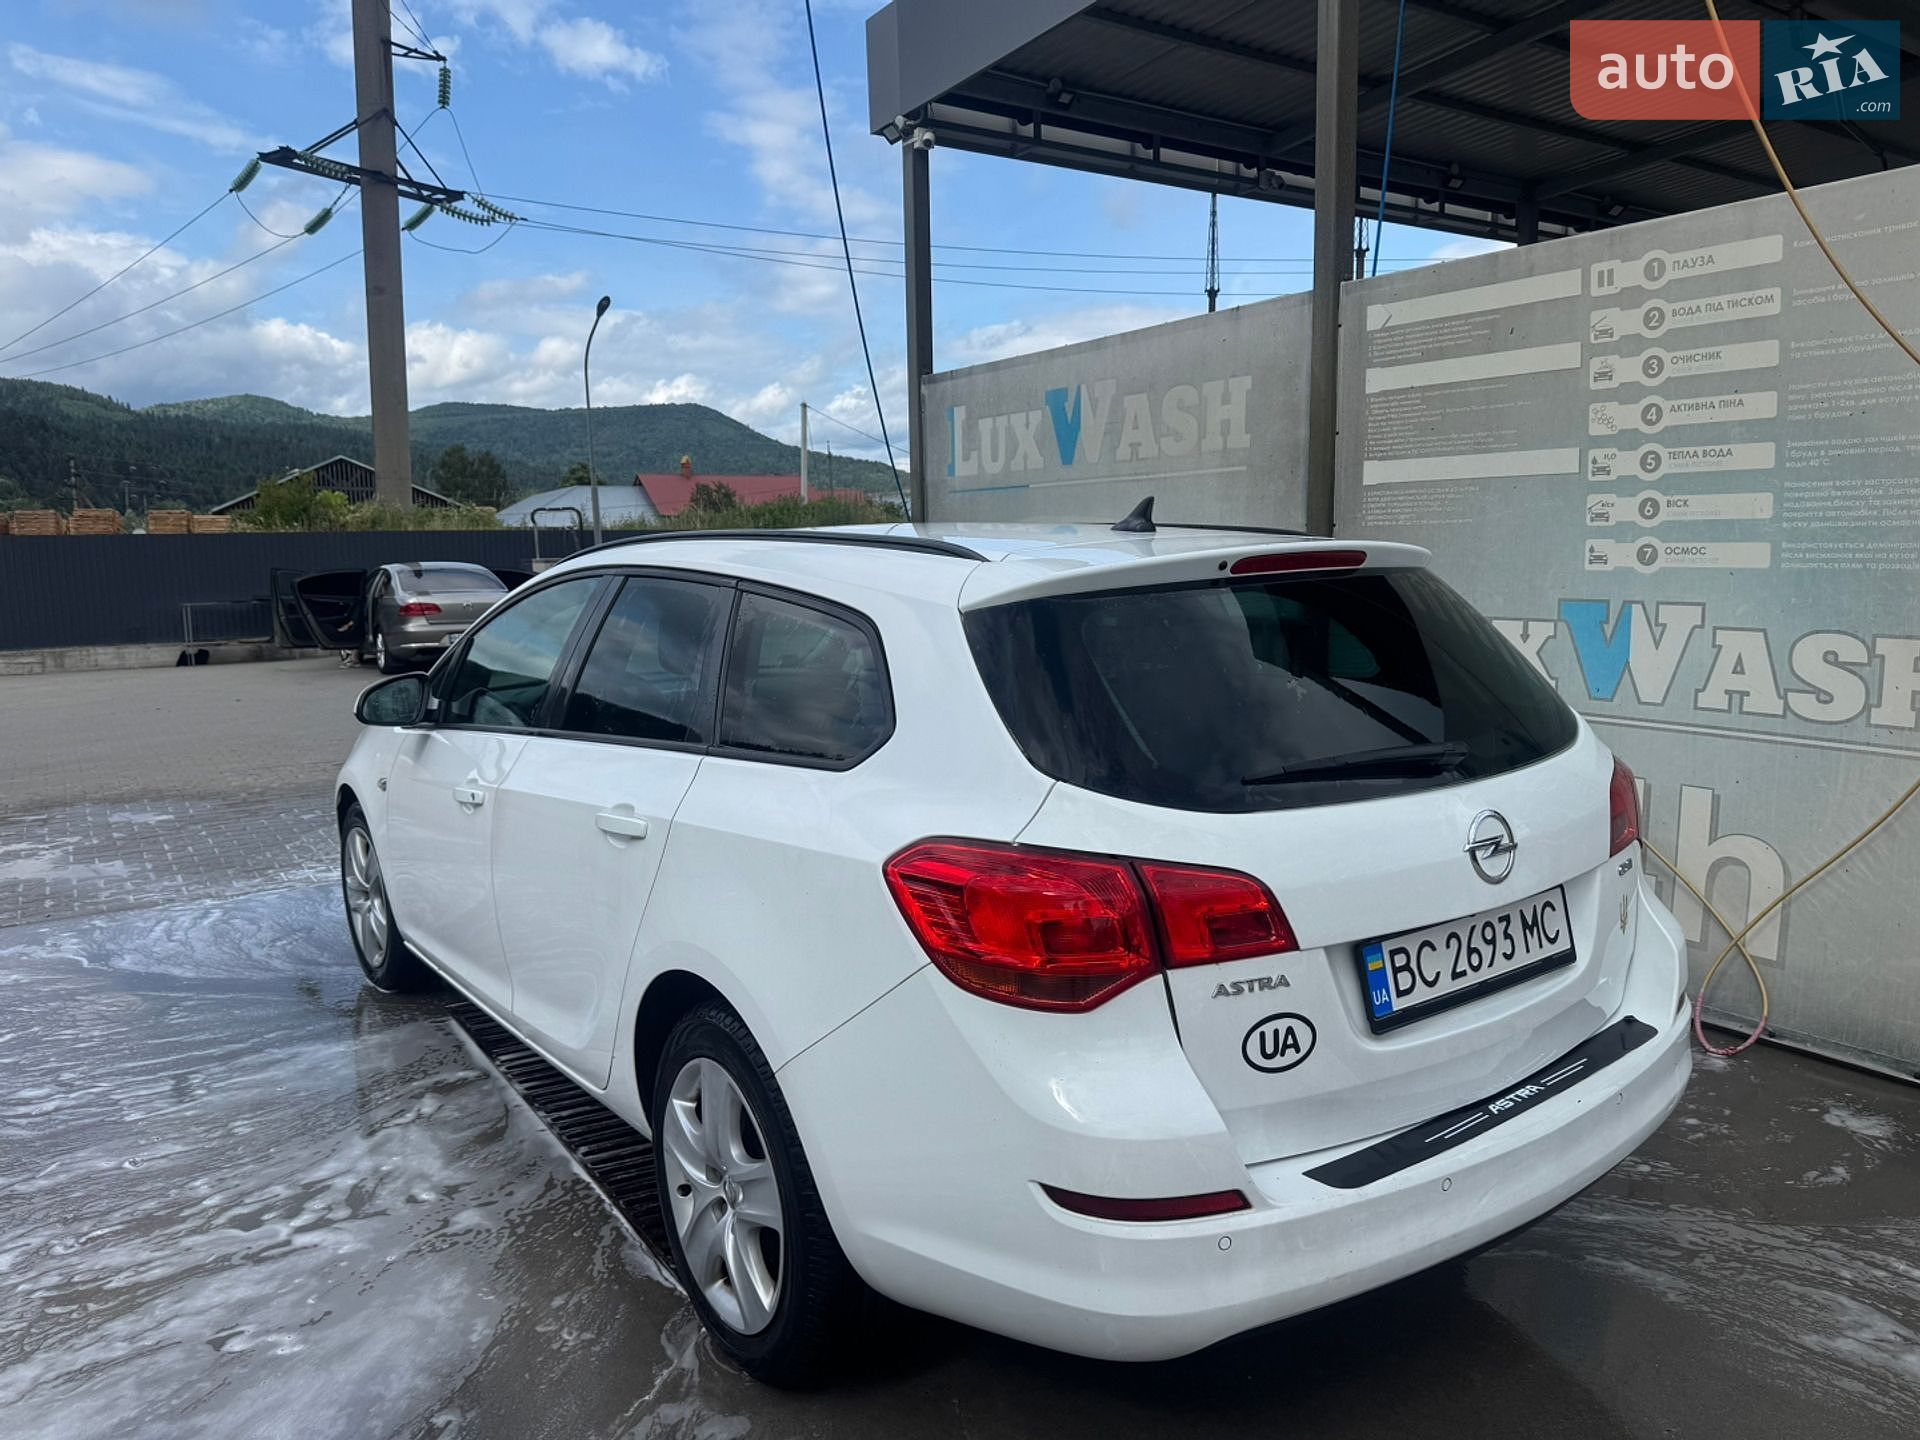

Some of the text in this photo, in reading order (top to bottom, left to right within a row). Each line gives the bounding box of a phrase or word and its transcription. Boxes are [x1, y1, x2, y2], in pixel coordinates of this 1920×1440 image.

[1671, 255, 1715, 272] ПАУЗА
[1671, 304, 1700, 318] ВОДА
[1705, 302, 1724, 313] ПІД
[1727, 294, 1775, 310] ТИСКОМ
[1670, 351, 1723, 366] ОЧИСНИК
[1669, 400, 1715, 414] АКТИВНА
[1718, 398, 1745, 409] ПІНА
[1667, 450, 1700, 461] ТЕПЛА
[1702, 448, 1734, 459] ВОДА
[1666, 499, 1689, 508] ВІСК
[1664, 546, 1707, 556] ОСМОС
[1389, 900, 1560, 998] BC 2693 MC
[1211, 974, 1290, 999] ASTRA
[1373, 988, 1390, 1006] UA
[1259, 1025, 1301, 1060] UA
[1488, 1085, 1545, 1114] ASTRA
